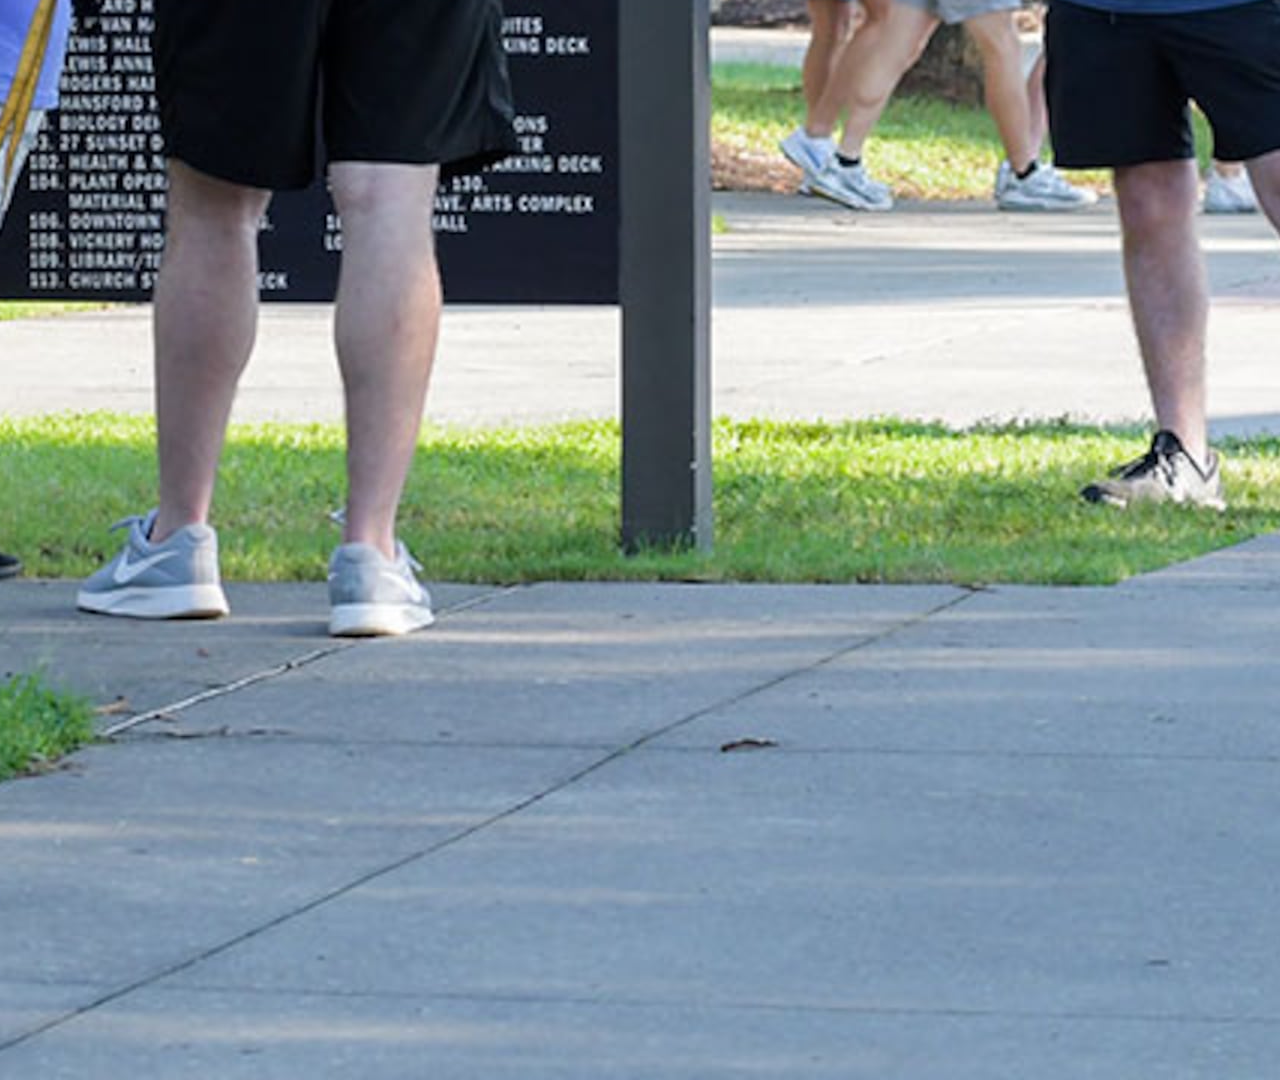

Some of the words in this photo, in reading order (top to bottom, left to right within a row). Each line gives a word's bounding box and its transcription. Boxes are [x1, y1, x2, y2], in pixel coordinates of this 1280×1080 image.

[545, 37, 590, 53] DECK
[59, 114, 128, 130] BIOLOGY
[85, 133, 147, 151] SUNSET
[69, 154, 129, 170] HEALTH
[557, 155, 602, 172] DECK
[69, 173, 118, 190] PLANT
[69, 194, 146, 210] MATERIAL
[471, 195, 513, 212] ARTS
[517, 195, 594, 213] COMPLEX
[69, 212, 161, 229] DOWNTOWN
[69, 271, 136, 289] CHURCH
